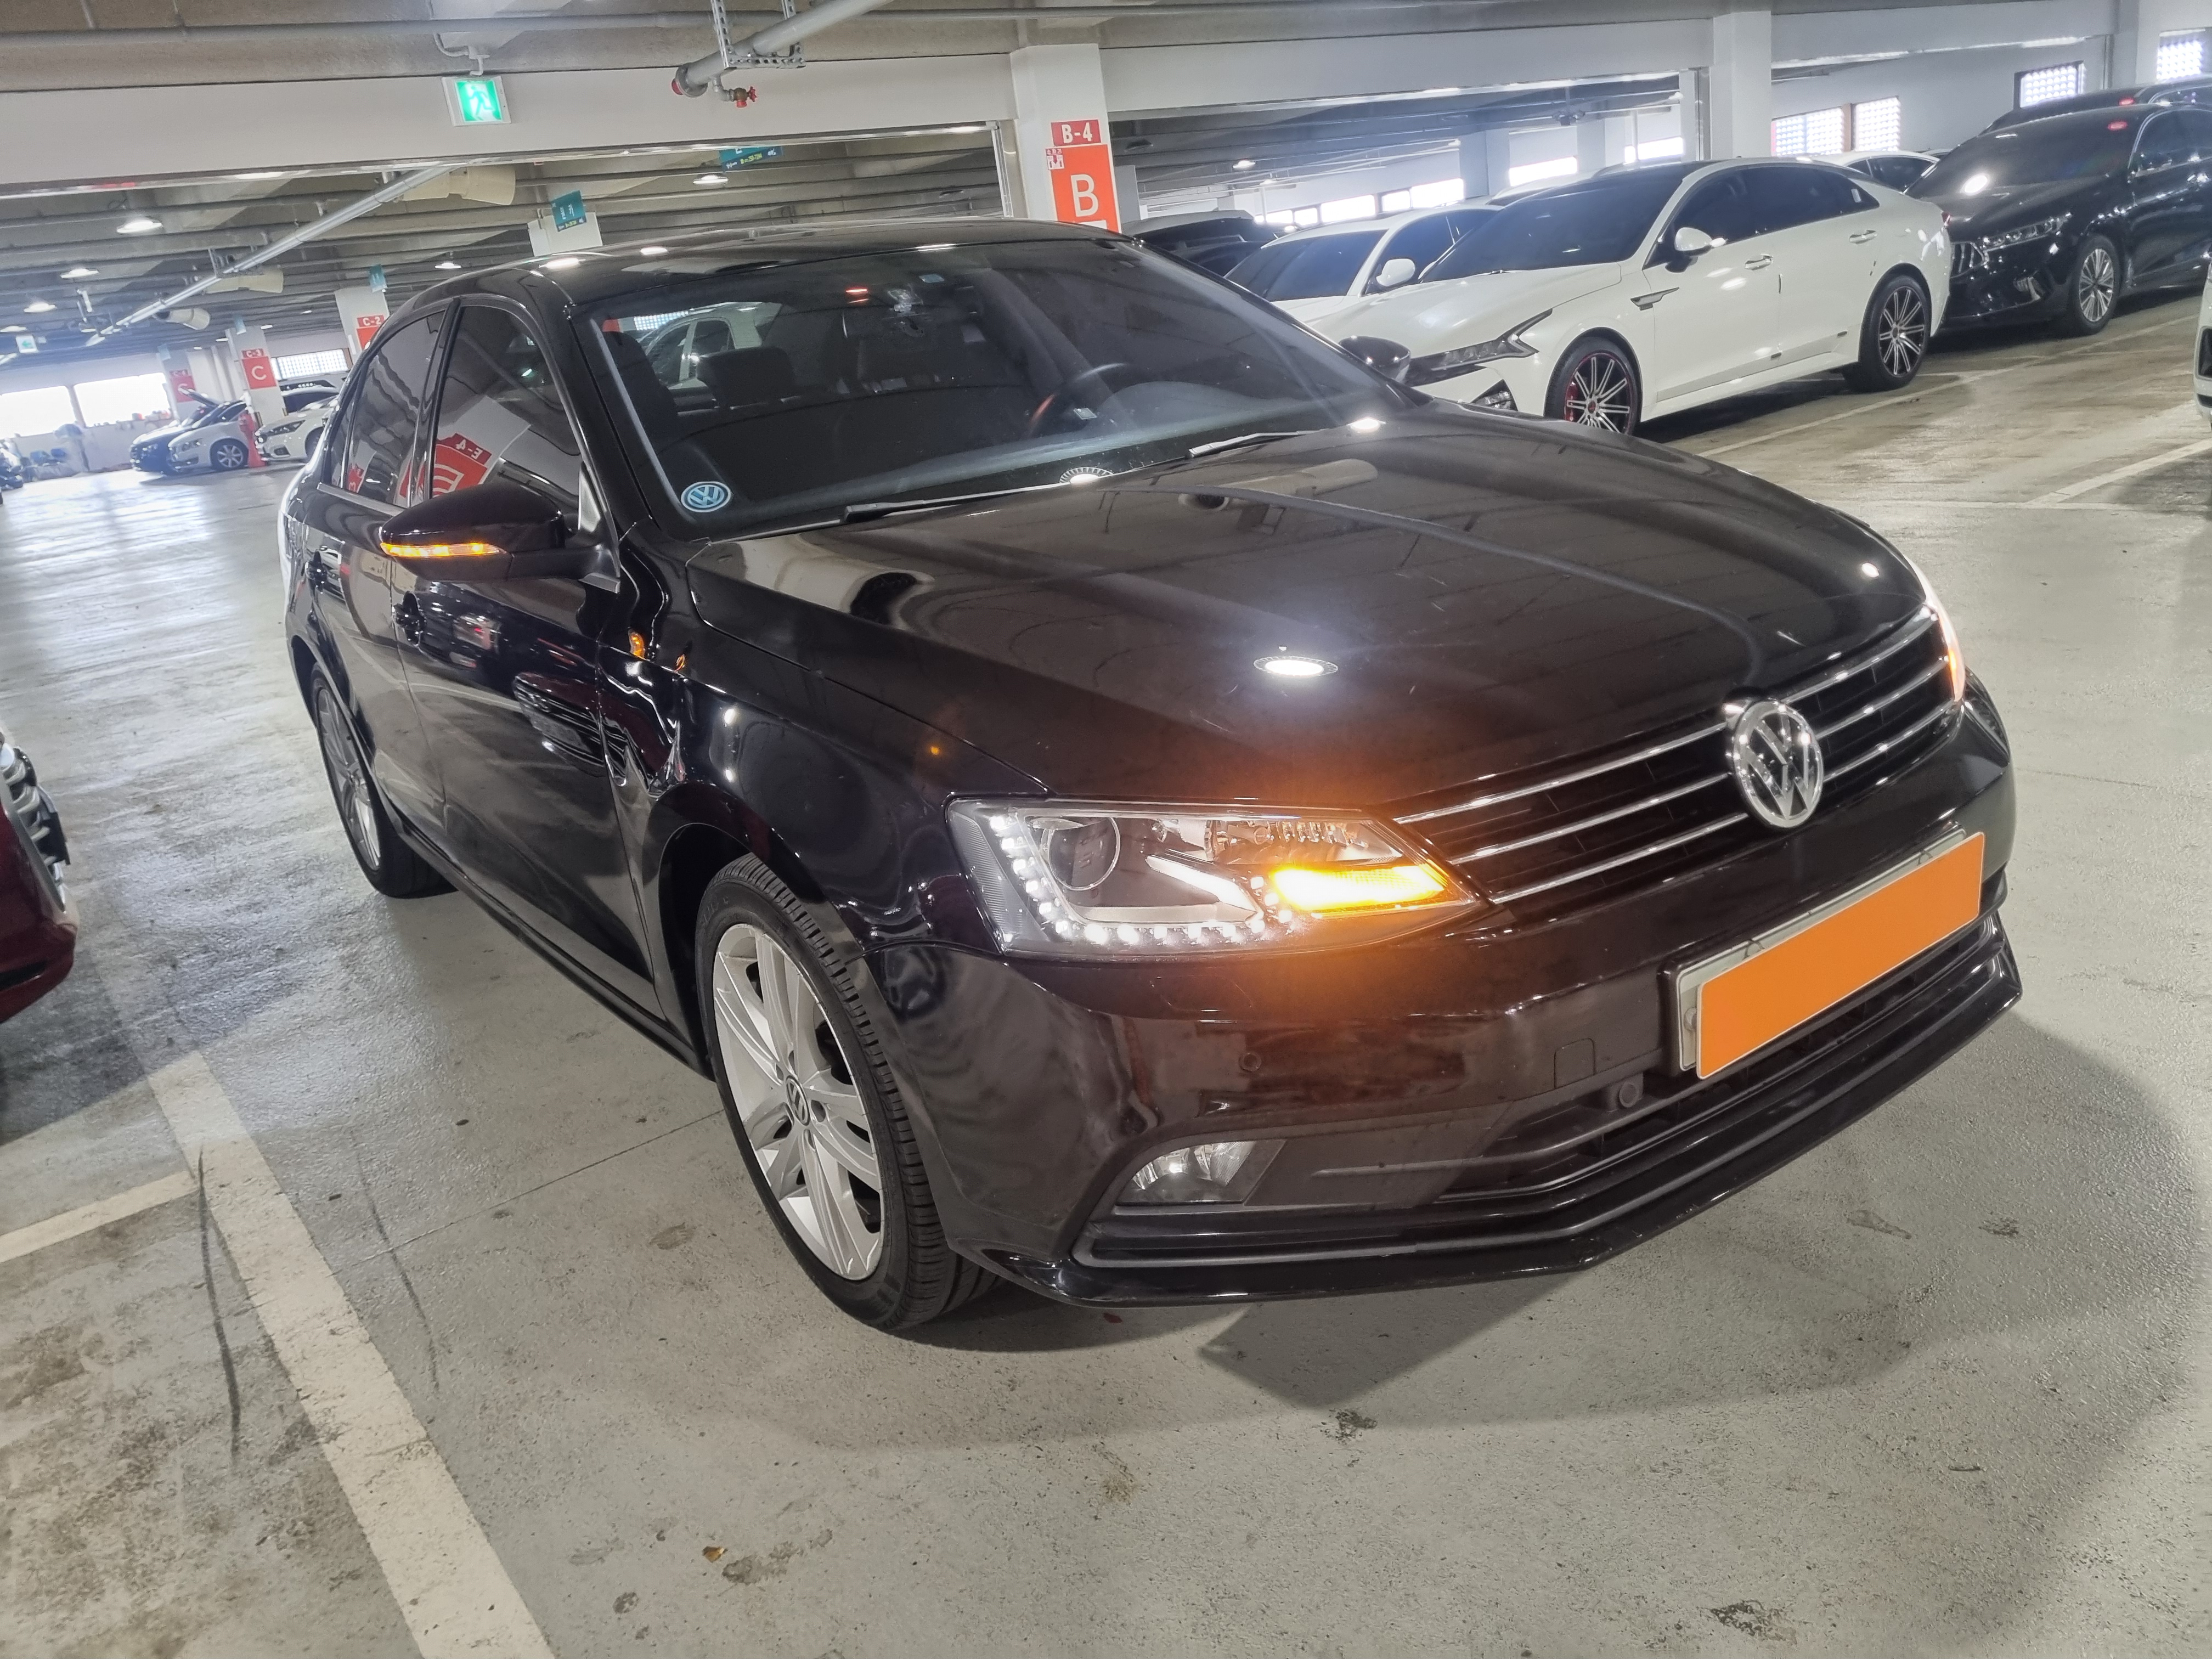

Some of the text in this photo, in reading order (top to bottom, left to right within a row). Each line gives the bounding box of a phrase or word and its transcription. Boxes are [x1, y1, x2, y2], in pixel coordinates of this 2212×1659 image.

[1062, 122, 1093, 143] B-4
[1071, 174, 1099, 217] B
[363, 317, 381, 326] C-2
[251, 365, 267, 380] C
